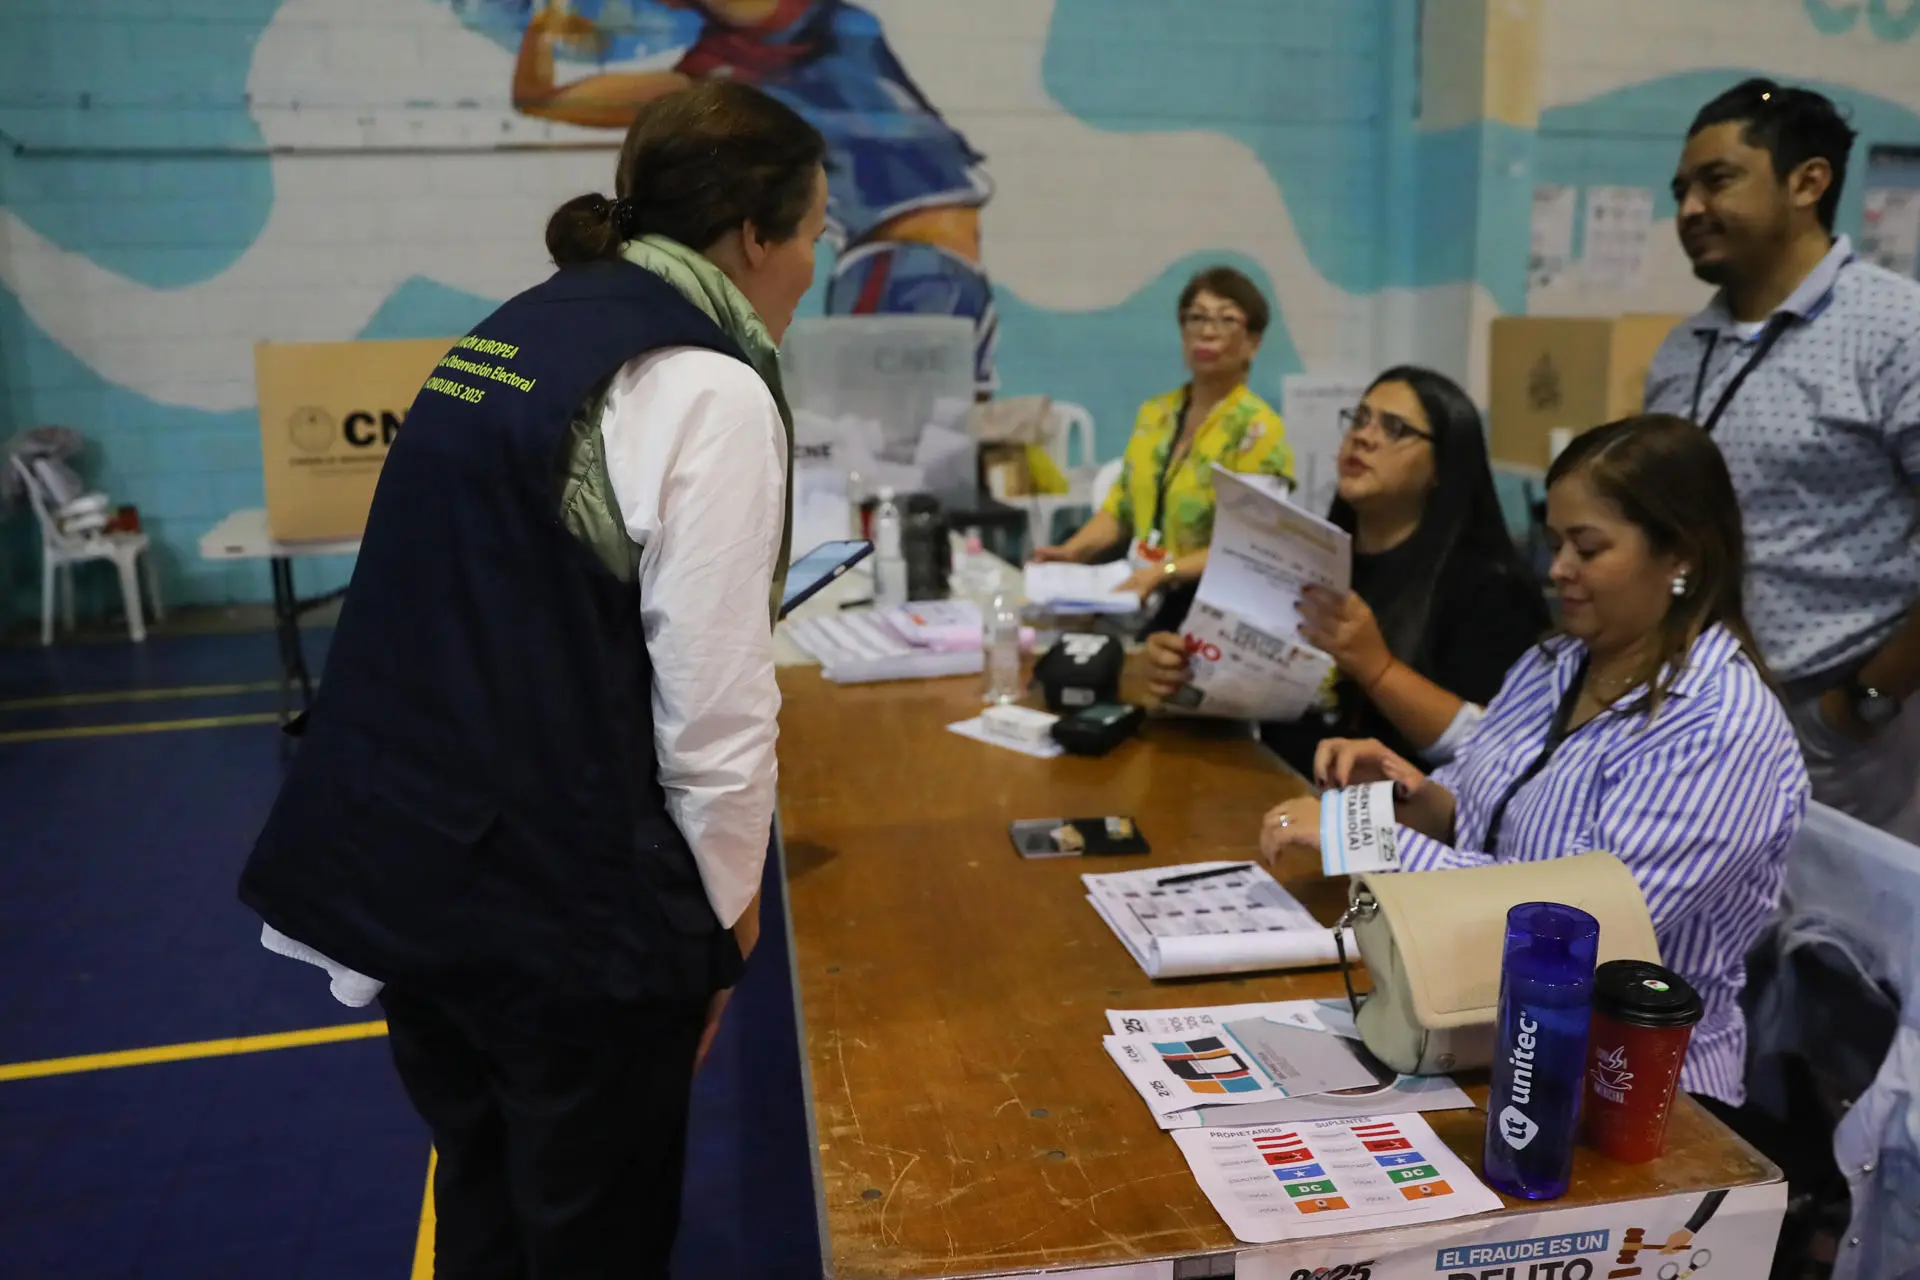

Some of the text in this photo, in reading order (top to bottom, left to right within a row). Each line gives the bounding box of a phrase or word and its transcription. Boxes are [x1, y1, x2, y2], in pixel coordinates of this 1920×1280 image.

[474, 339, 519, 360] EUROPEA
[446, 355, 493, 378] Observación
[489, 366, 537, 393] Electoral
[459, 386, 486, 404] 2025
[1314, 1117, 1372, 1129] SUPLENTES
[1209, 1127, 1283, 1139] PROPIETARIOS
[1400, 1168, 1425, 1179] DC
[1298, 1184, 1323, 1193] DC
[1442, 1234, 1603, 1267] EL FRAUDE ES UN
